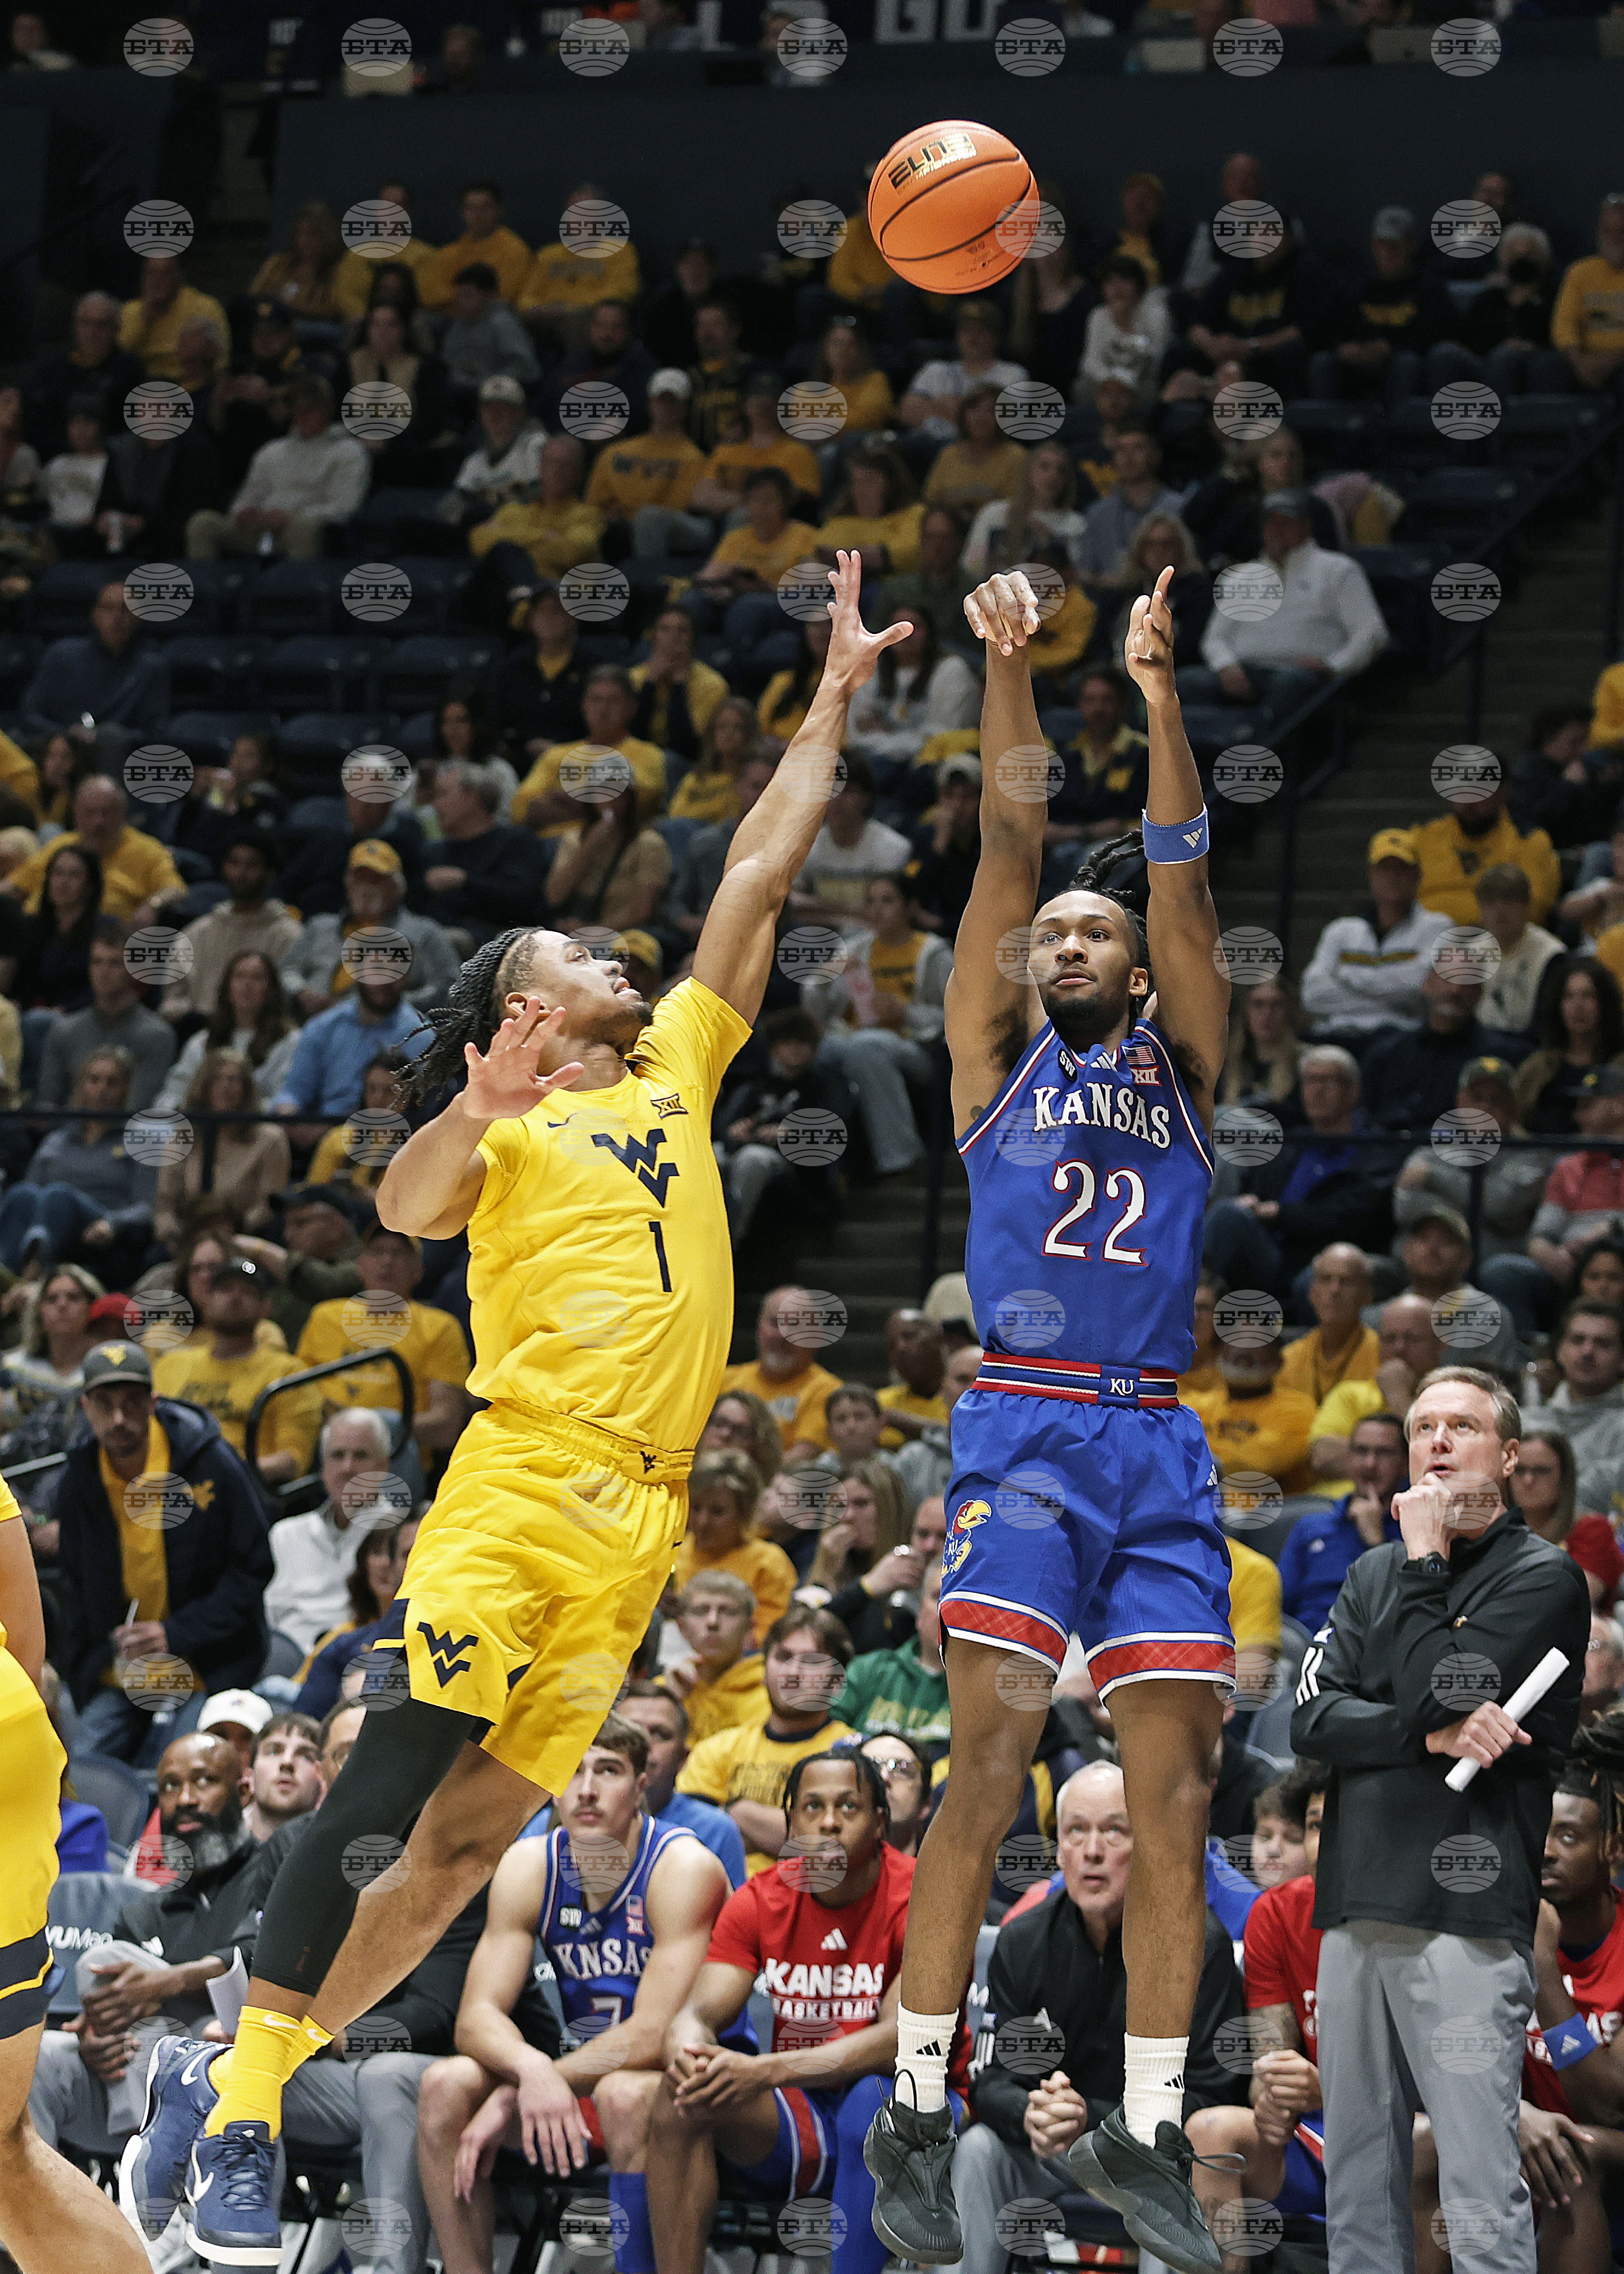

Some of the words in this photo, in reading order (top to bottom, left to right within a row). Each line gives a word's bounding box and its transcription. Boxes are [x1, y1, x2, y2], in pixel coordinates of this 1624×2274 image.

[1130, 1067, 1159, 1084] XII
[1033, 1083, 1170, 1149] KANSAS
[1041, 1158, 1148, 1267] 22
[649, 1221, 672, 1292] 1
[1110, 1378, 1134, 1396] KU
